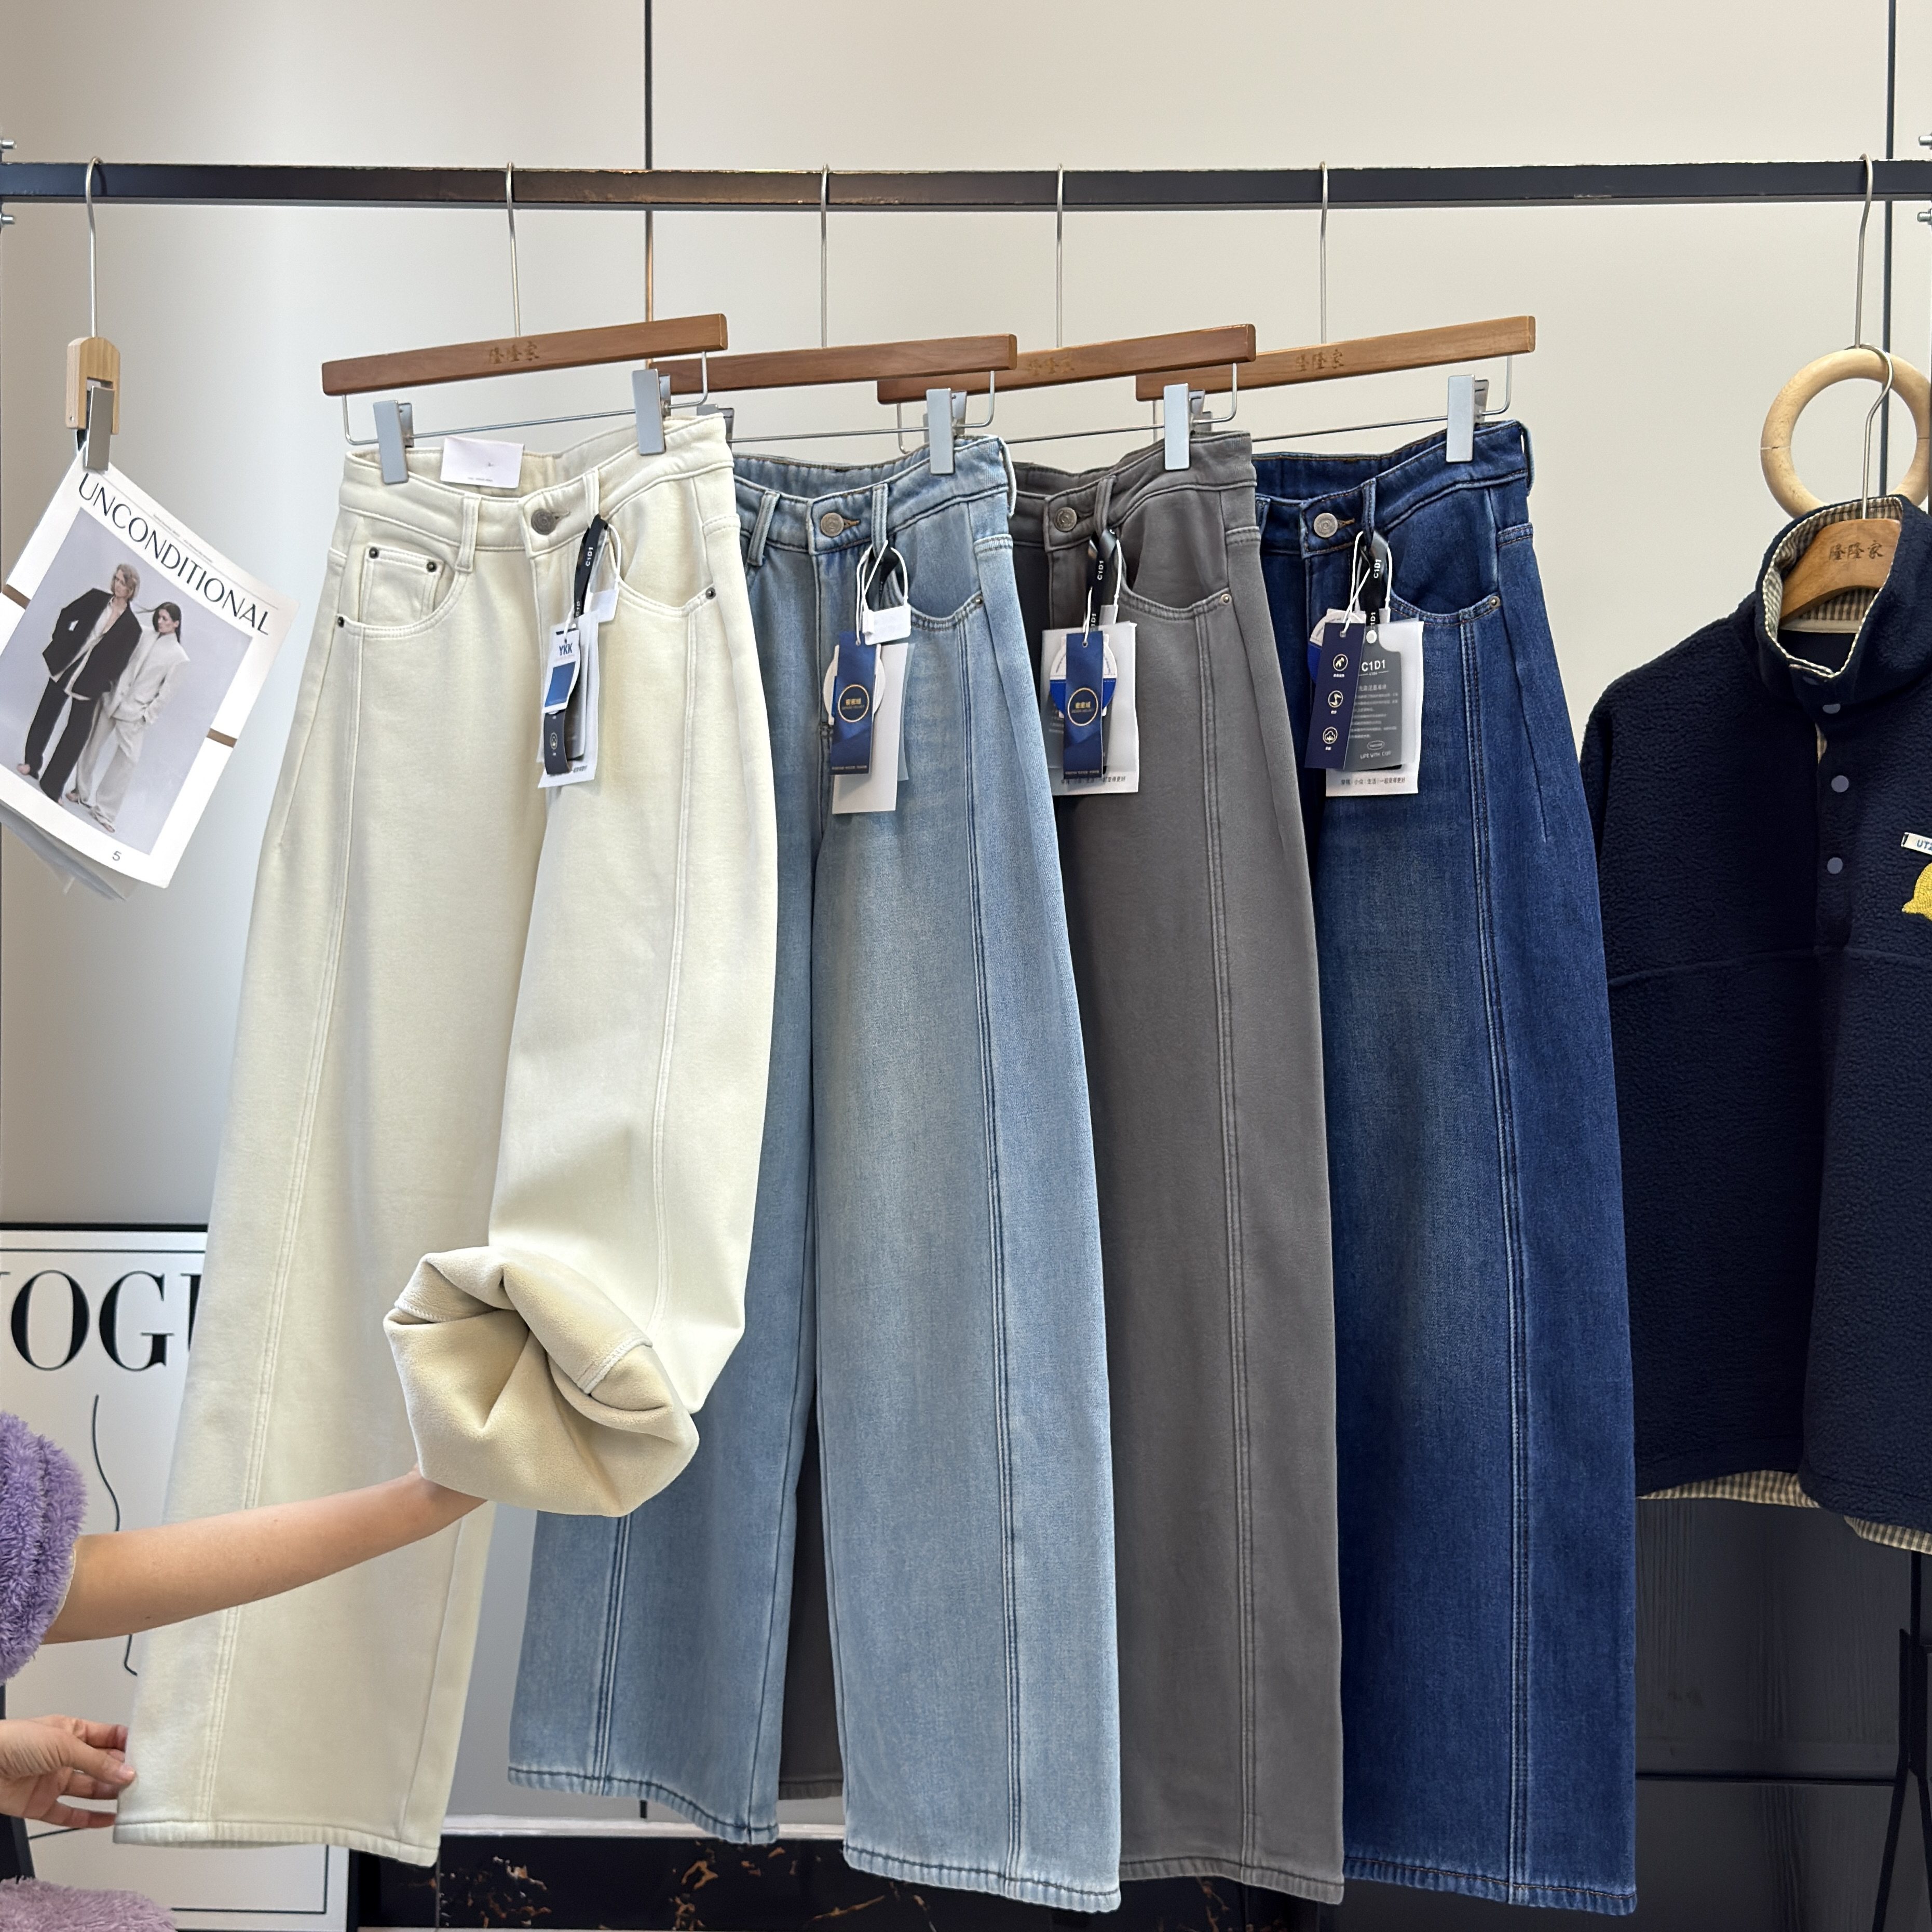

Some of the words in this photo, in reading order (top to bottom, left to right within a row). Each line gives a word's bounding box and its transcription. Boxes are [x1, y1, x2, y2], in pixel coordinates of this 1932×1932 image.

[79, 473, 268, 635] UNCONDITIONAL
[585, 547, 593, 567] C1D1
[1373, 559, 1381, 579] C1D1
[559, 643, 573, 656] YKK
[1361, 659, 1385, 672] C1D1
[113, 851, 122, 861] 5
